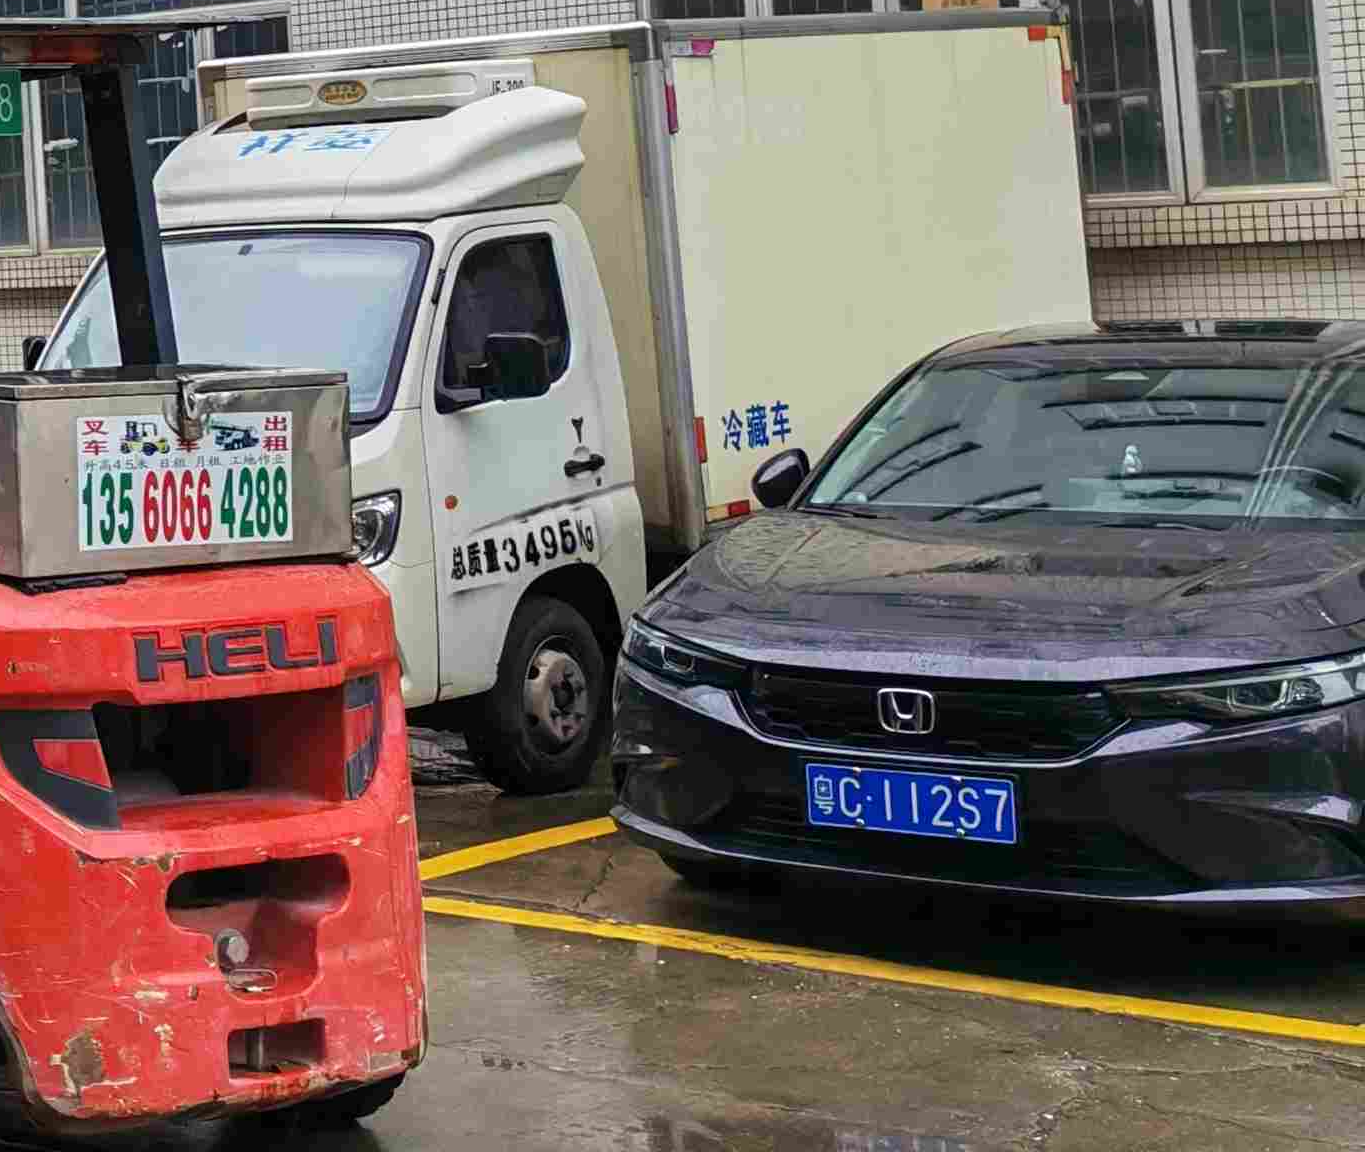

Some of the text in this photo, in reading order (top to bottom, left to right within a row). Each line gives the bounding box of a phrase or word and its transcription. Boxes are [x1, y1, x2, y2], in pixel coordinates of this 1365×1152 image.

[82, 420, 109, 456] 叉车
[262, 415, 289, 452] 出租
[721, 400, 792, 452] 冷藏车
[82, 465, 289, 546] 135 6066 4288
[133, 615, 339, 682] HELI
